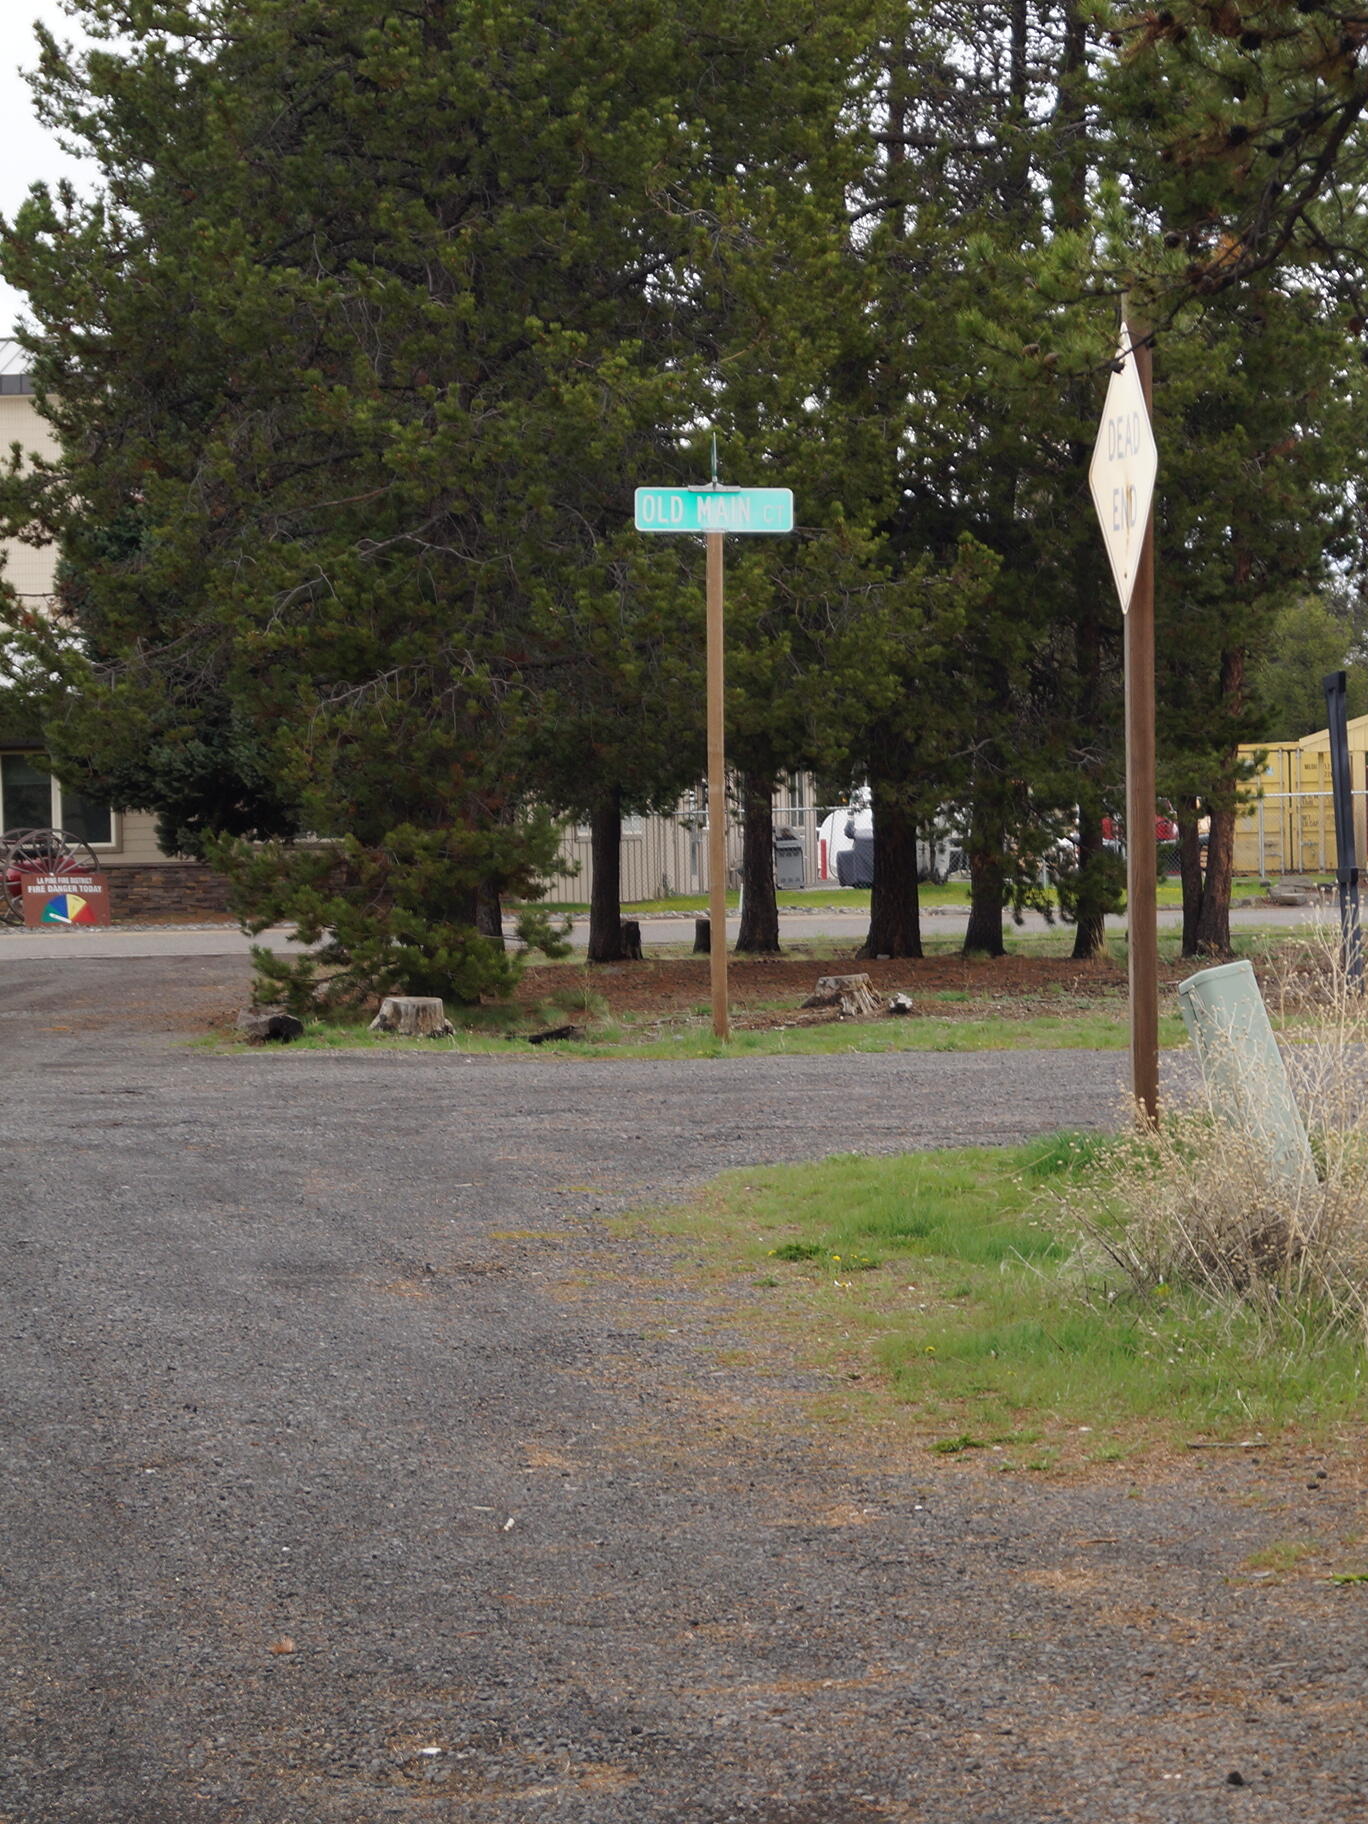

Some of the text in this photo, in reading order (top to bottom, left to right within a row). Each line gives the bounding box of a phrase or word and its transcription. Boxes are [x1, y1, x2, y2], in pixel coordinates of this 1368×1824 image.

[1108, 411, 1140, 462] DEAD
[642, 494, 784, 524] OLD MAIN CT
[1112, 484, 1137, 531] END
[27, 884, 102, 893] FIRE DANGER TODAY
